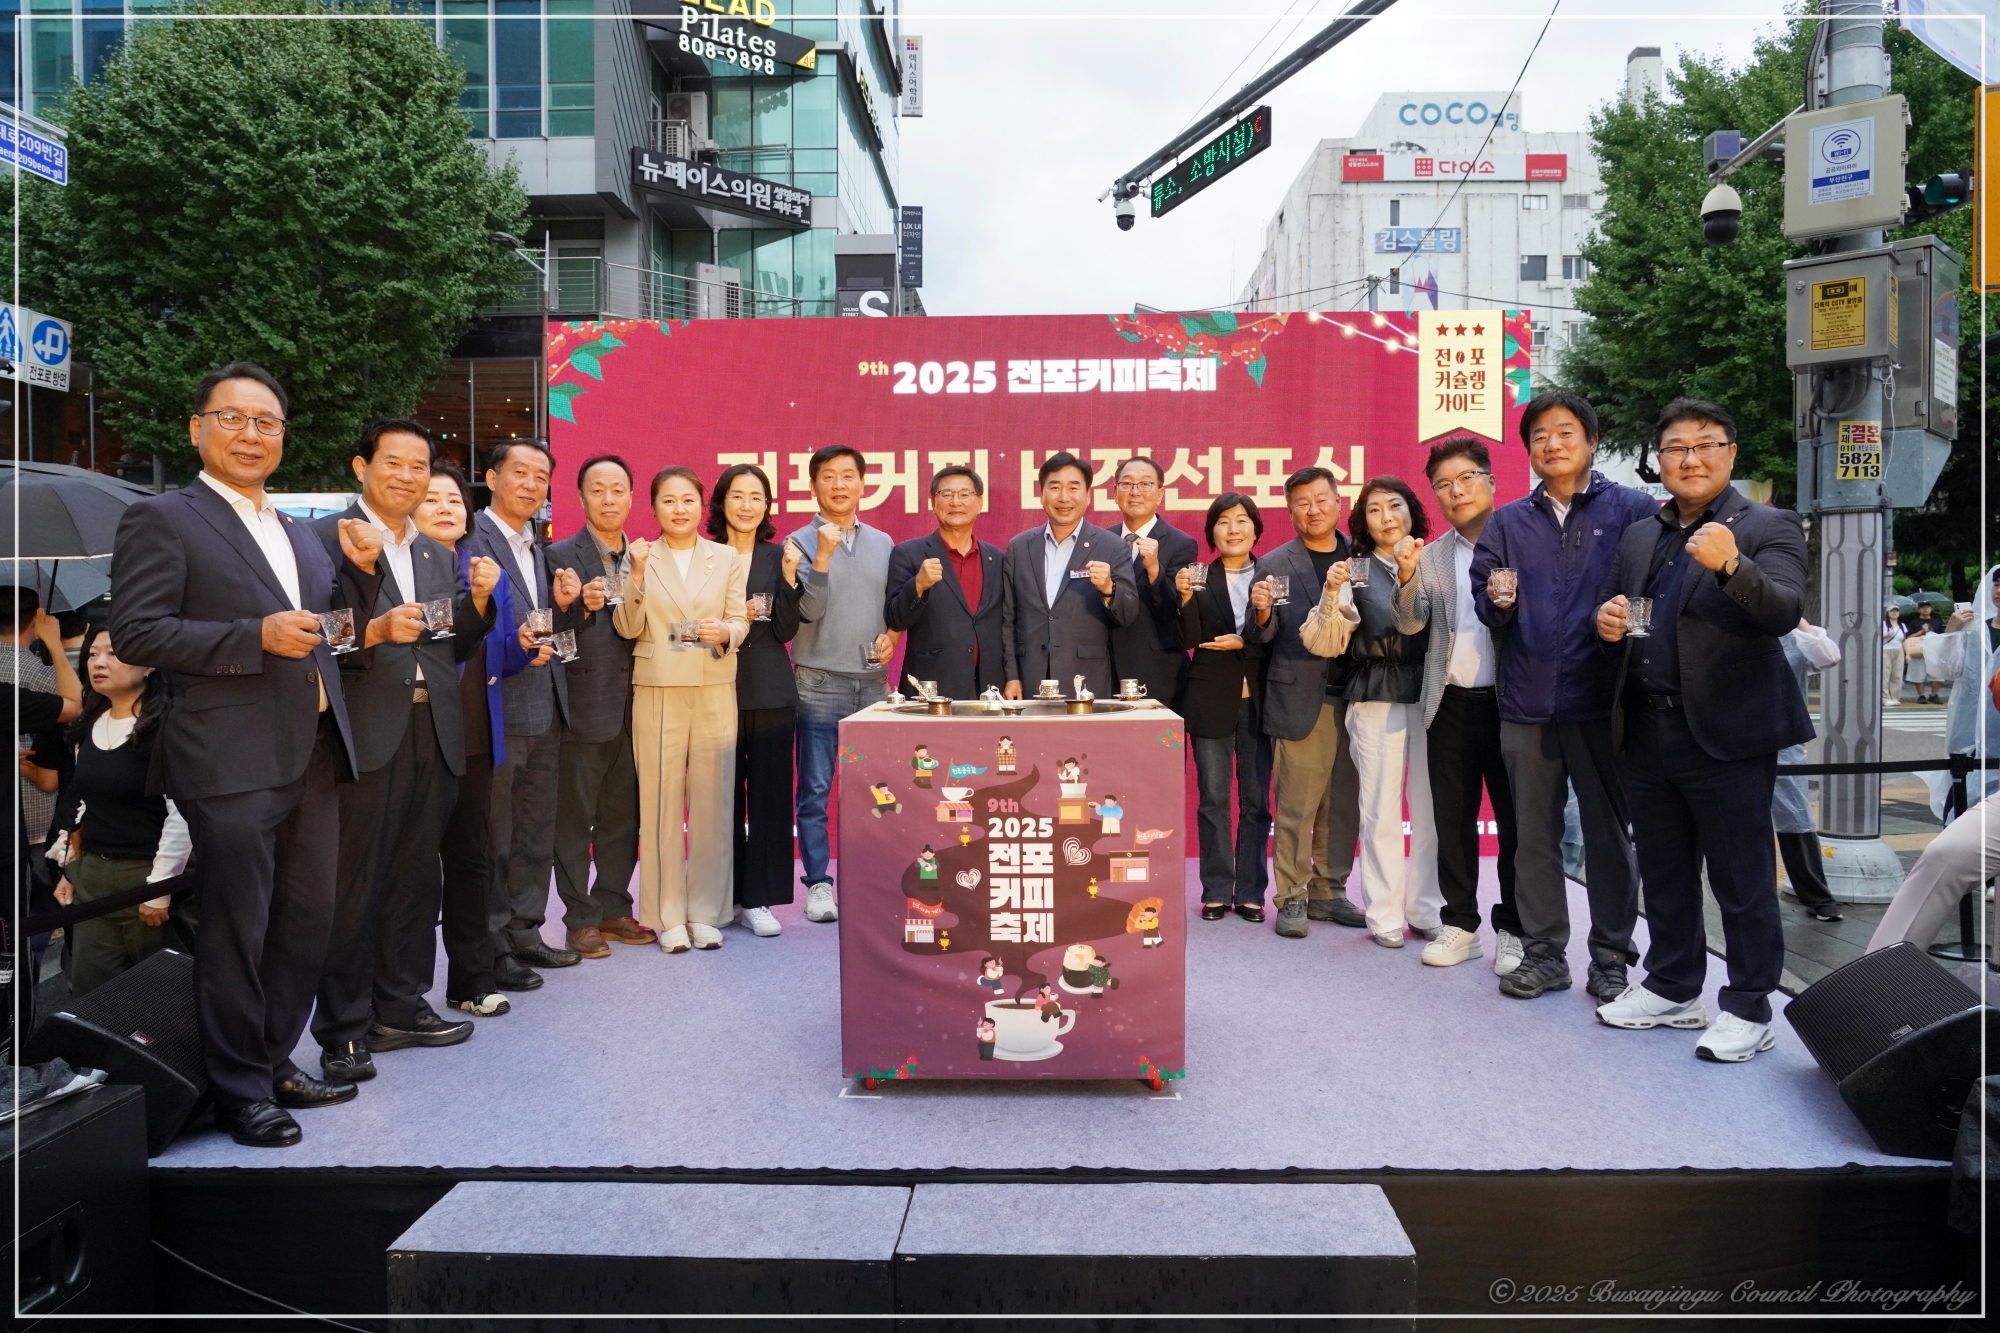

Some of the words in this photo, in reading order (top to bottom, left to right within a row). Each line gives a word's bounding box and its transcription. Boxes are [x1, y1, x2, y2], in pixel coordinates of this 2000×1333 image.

[679, 0, 776, 27] AD
[679, 5, 777, 57] Pilates
[678, 34, 775, 76] 808-9898
[803, 56, 815, 67] 4F
[908, 54, 917, 105] 렉시스어학원
[1400, 102, 1488, 125] COCO
[1439, 161, 1495, 174] 다이소
[638, 153, 771, 210] 뉴페이스의원
[1829, 174, 1853, 183] 부산진구
[903, 231, 921, 239] 디자인
[1381, 229, 1457, 251] 킴스볼링
[859, 290, 890, 318] S
[1831, 299, 1845, 307] CCTV
[858, 361, 889, 376] 9th
[893, 361, 997, 394] 2025
[1007, 358, 1217, 393] 전포커피축제
[1434, 370, 1486, 390] 커슐랭
[1434, 393, 1486, 413] 가이드
[1851, 424, 1879, 444] 결혼
[1839, 452, 1880, 465] 5821
[1840, 444, 1856, 452] 010
[1839, 465, 1880, 478] 7113
[987, 797, 1019, 813] 9th
[988, 817, 1054, 838] 2025
[988, 843, 1054, 874] 전포
[989, 877, 1054, 909] 커피
[990, 912, 1055, 943] 축제
